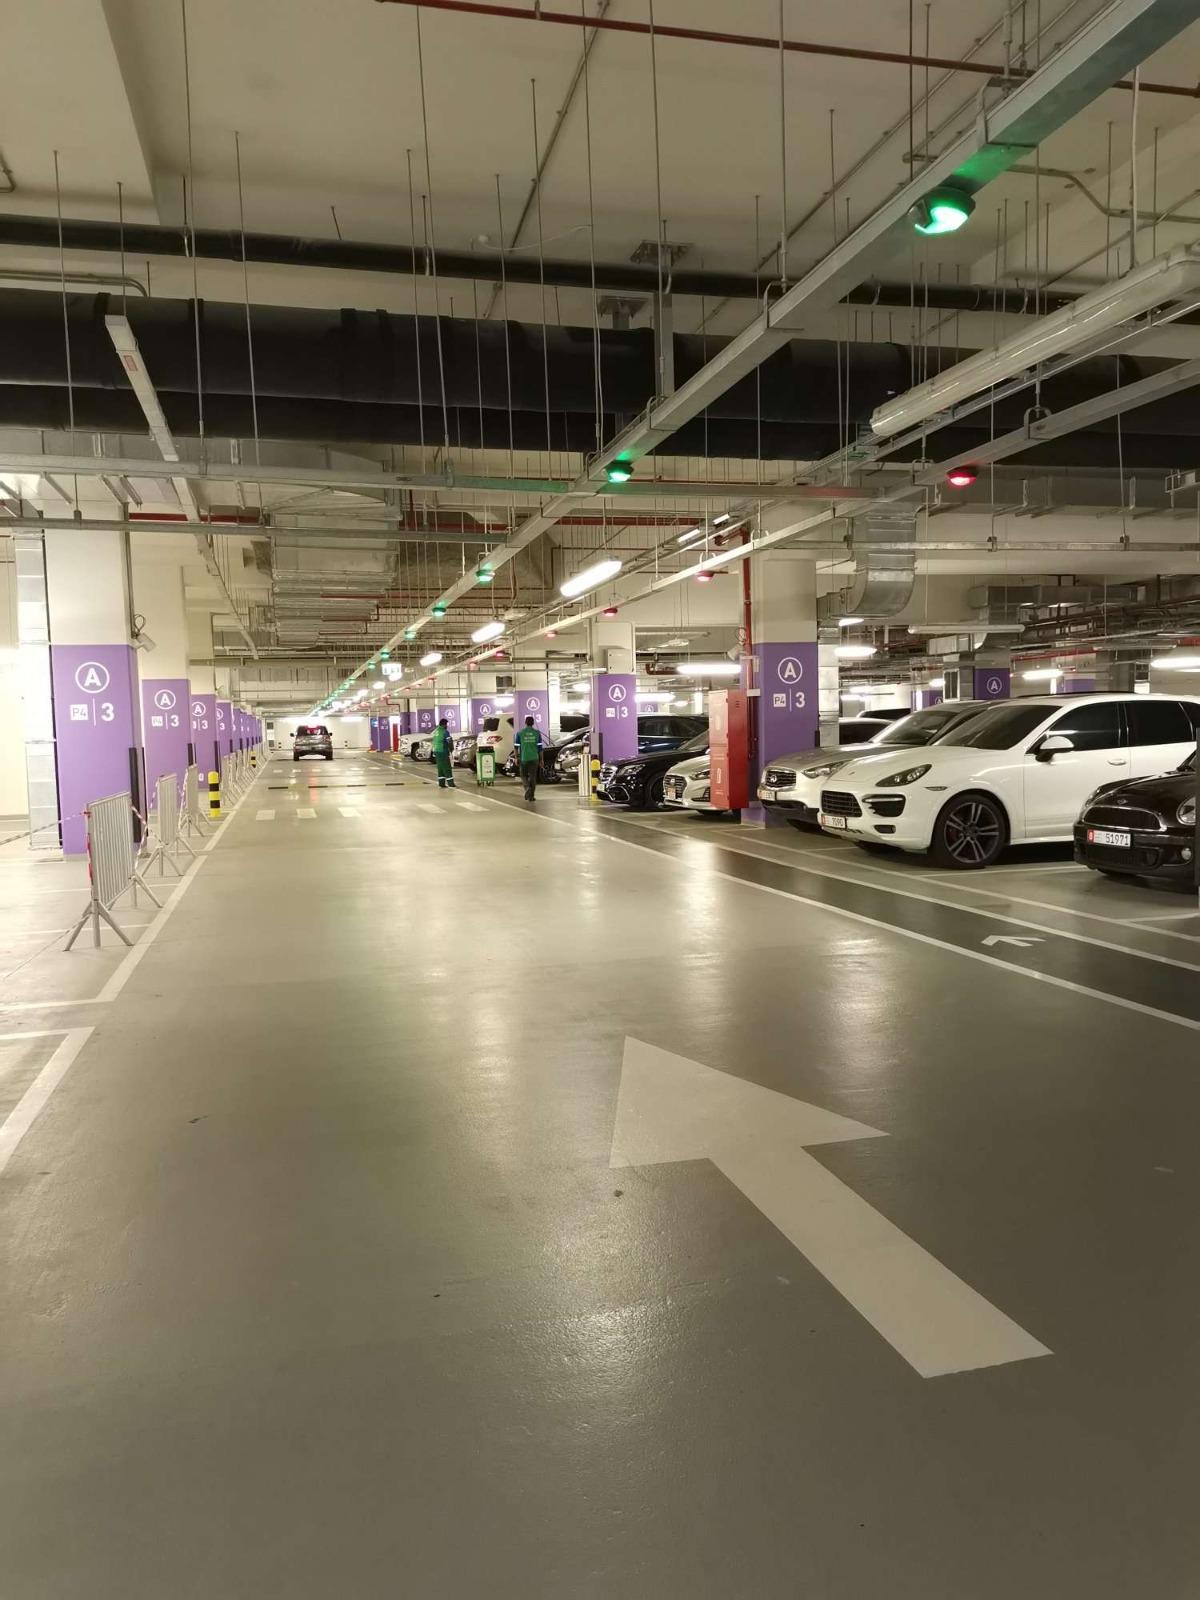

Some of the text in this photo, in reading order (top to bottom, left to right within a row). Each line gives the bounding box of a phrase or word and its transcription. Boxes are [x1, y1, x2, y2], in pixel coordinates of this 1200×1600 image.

[784, 662, 797, 679] A
[84, 667, 101, 687] A
[991, 681, 999, 690] A
[613, 687, 622, 699] A
[160, 693, 171, 706] A
[529, 699, 538, 710] A
[774, 692, 806, 708] P4 3
[71, 703, 115, 721] P4 3
[194, 704, 202, 714] A
[447, 709, 454, 717] A
[482, 705, 488, 713] A
[621, 706, 628, 718] 3
[170, 715, 179, 727] 3
[202, 720, 208, 729] 3
[535, 714, 542, 723] 3
[1105, 832, 1129, 846] 51971
